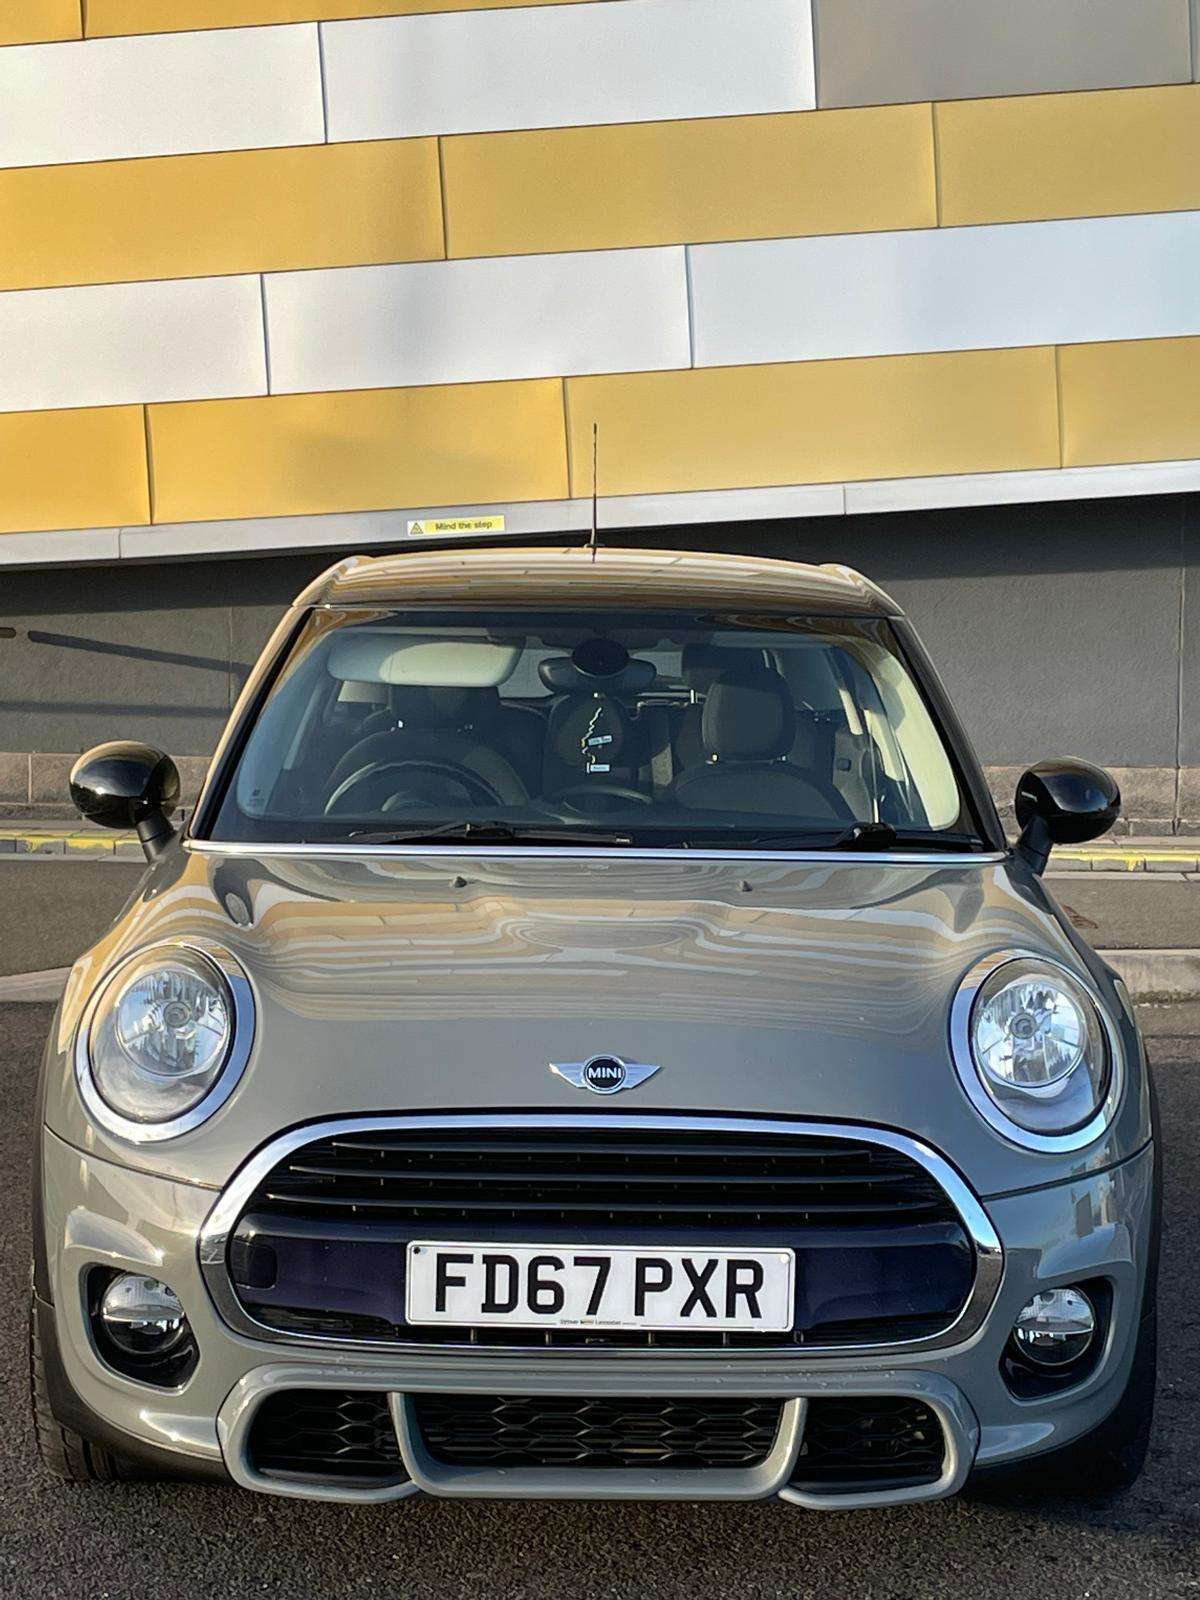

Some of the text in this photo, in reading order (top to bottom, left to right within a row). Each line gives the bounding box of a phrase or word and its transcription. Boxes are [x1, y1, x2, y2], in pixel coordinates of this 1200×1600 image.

[435, 520, 493, 531] Mind the step
[588, 1067, 622, 1079] MINI
[435, 1253, 764, 1319] FD67 PXR
